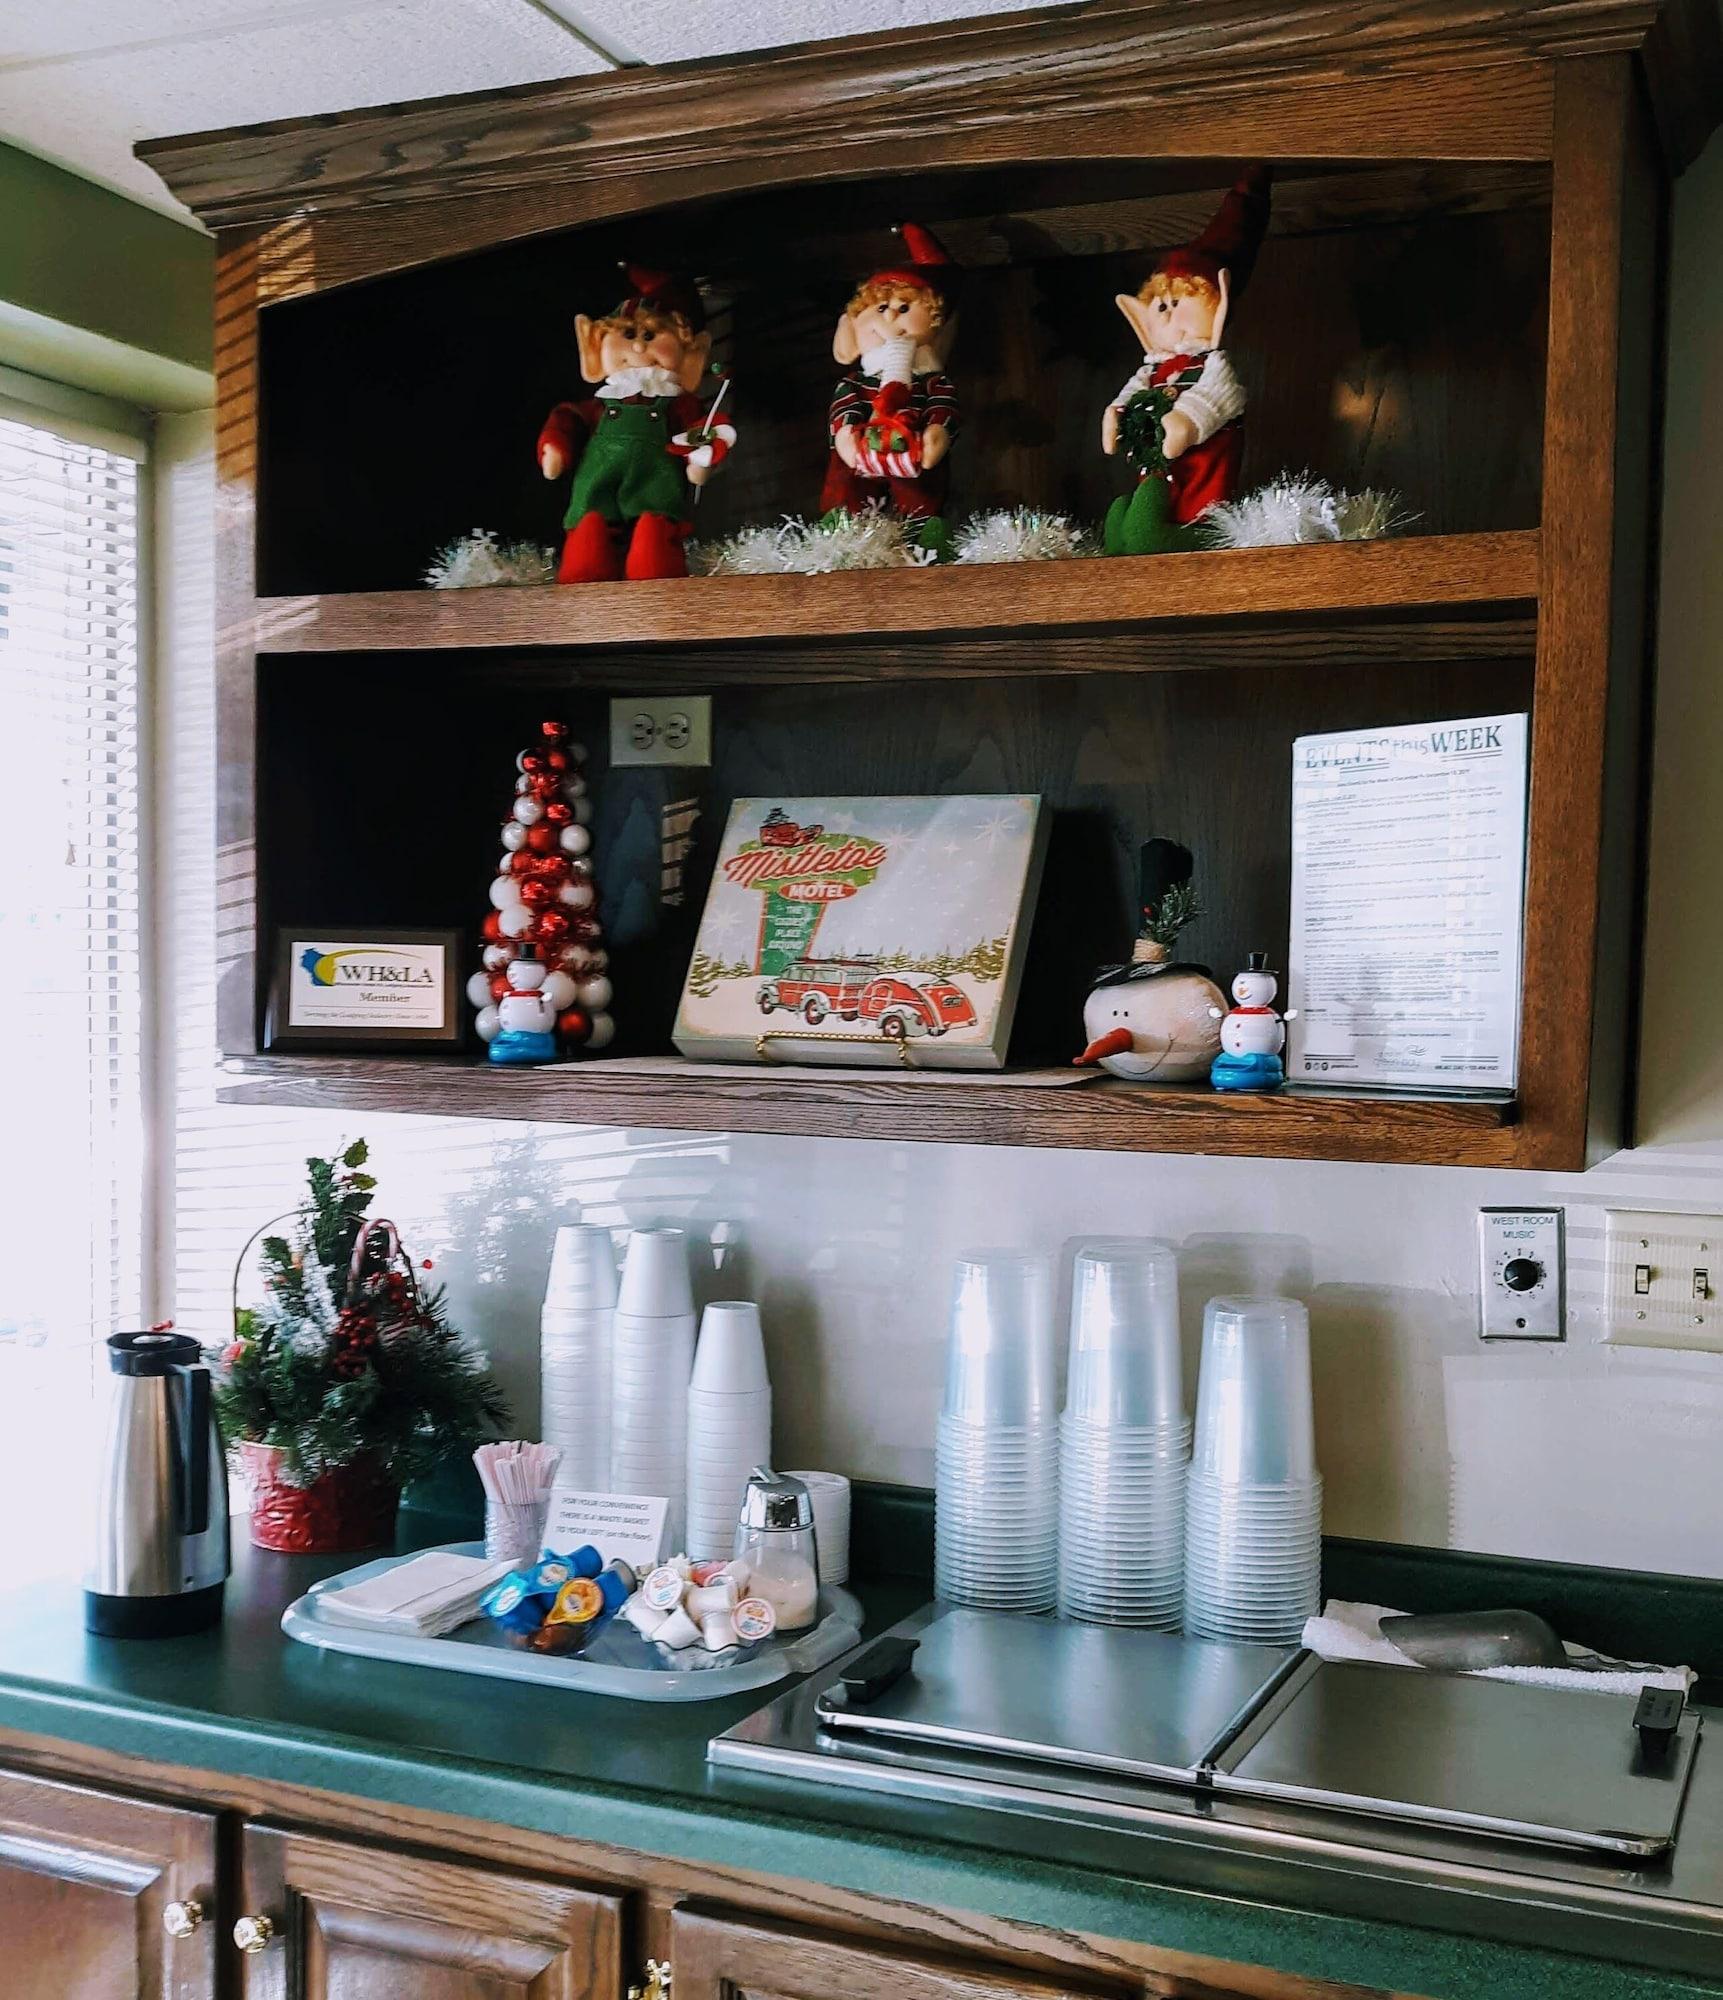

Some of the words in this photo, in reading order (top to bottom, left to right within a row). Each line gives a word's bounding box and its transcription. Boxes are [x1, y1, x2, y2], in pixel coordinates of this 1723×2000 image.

[1431, 725, 1502, 753] WEEK
[723, 840, 888, 888] Mistletoe
[788, 883, 847, 899] MOTEL
[340, 965, 434, 983] WH&LA
[1491, 1216, 1520, 1226] WEST
[1523, 1216, 1554, 1226] ROOM
[1502, 1230, 1537, 1240] MUSIC
